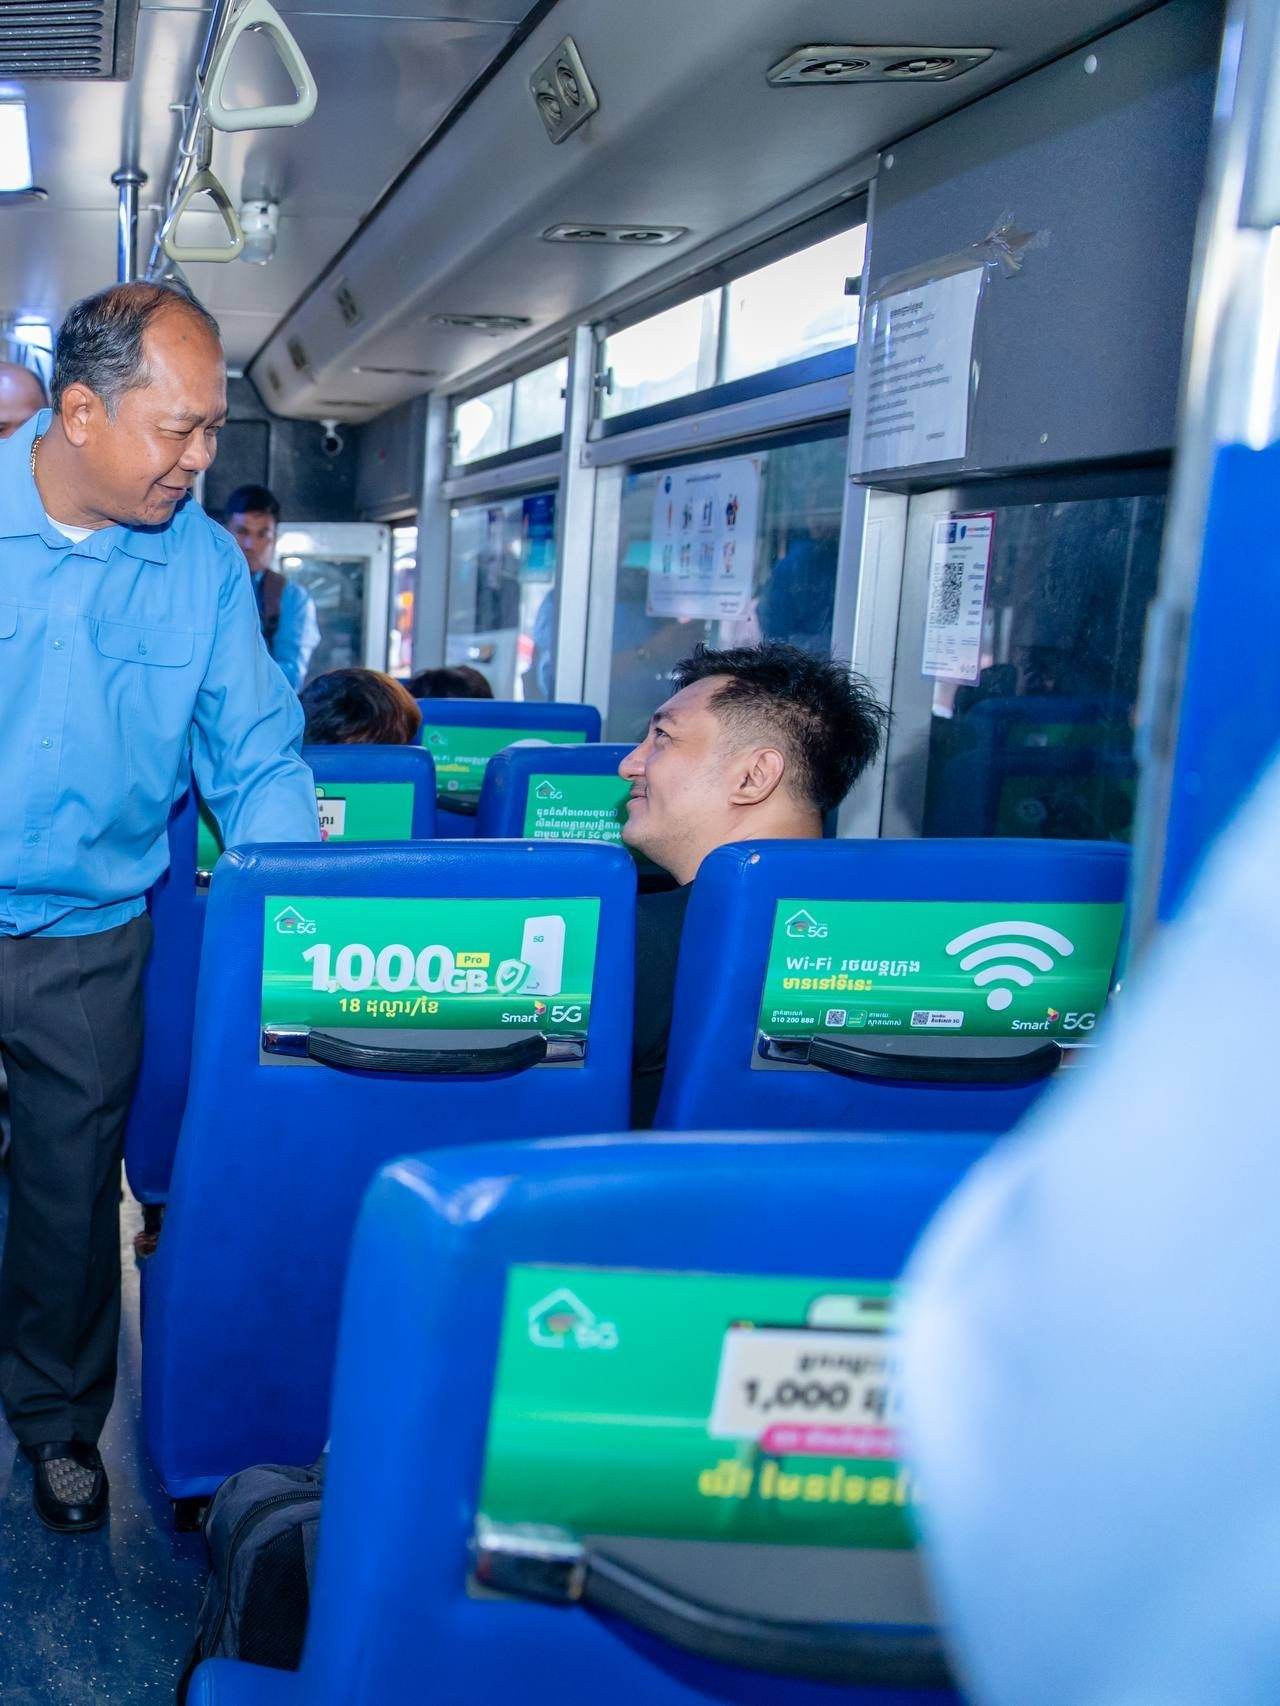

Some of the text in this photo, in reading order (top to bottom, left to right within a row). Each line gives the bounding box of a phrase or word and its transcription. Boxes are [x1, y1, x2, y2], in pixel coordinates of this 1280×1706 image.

[549, 791, 563, 799] 5G
[562, 830, 586, 838] Wi-Fi
[296, 922, 317, 934] 5G
[807, 926, 828, 938] 5G
[532, 935, 544, 943] 5G
[464, 955, 482, 964] Pro
[786, 957, 832, 971] Wi-Fi
[302, 943, 455, 993] 1,000
[444, 969, 489, 994] GB
[339, 998, 361, 1013] 18
[501, 1006, 583, 1023] Smart 5G
[1011, 1012, 1096, 1030] Smart 5G
[743, 1378, 851, 1412] 1,000
